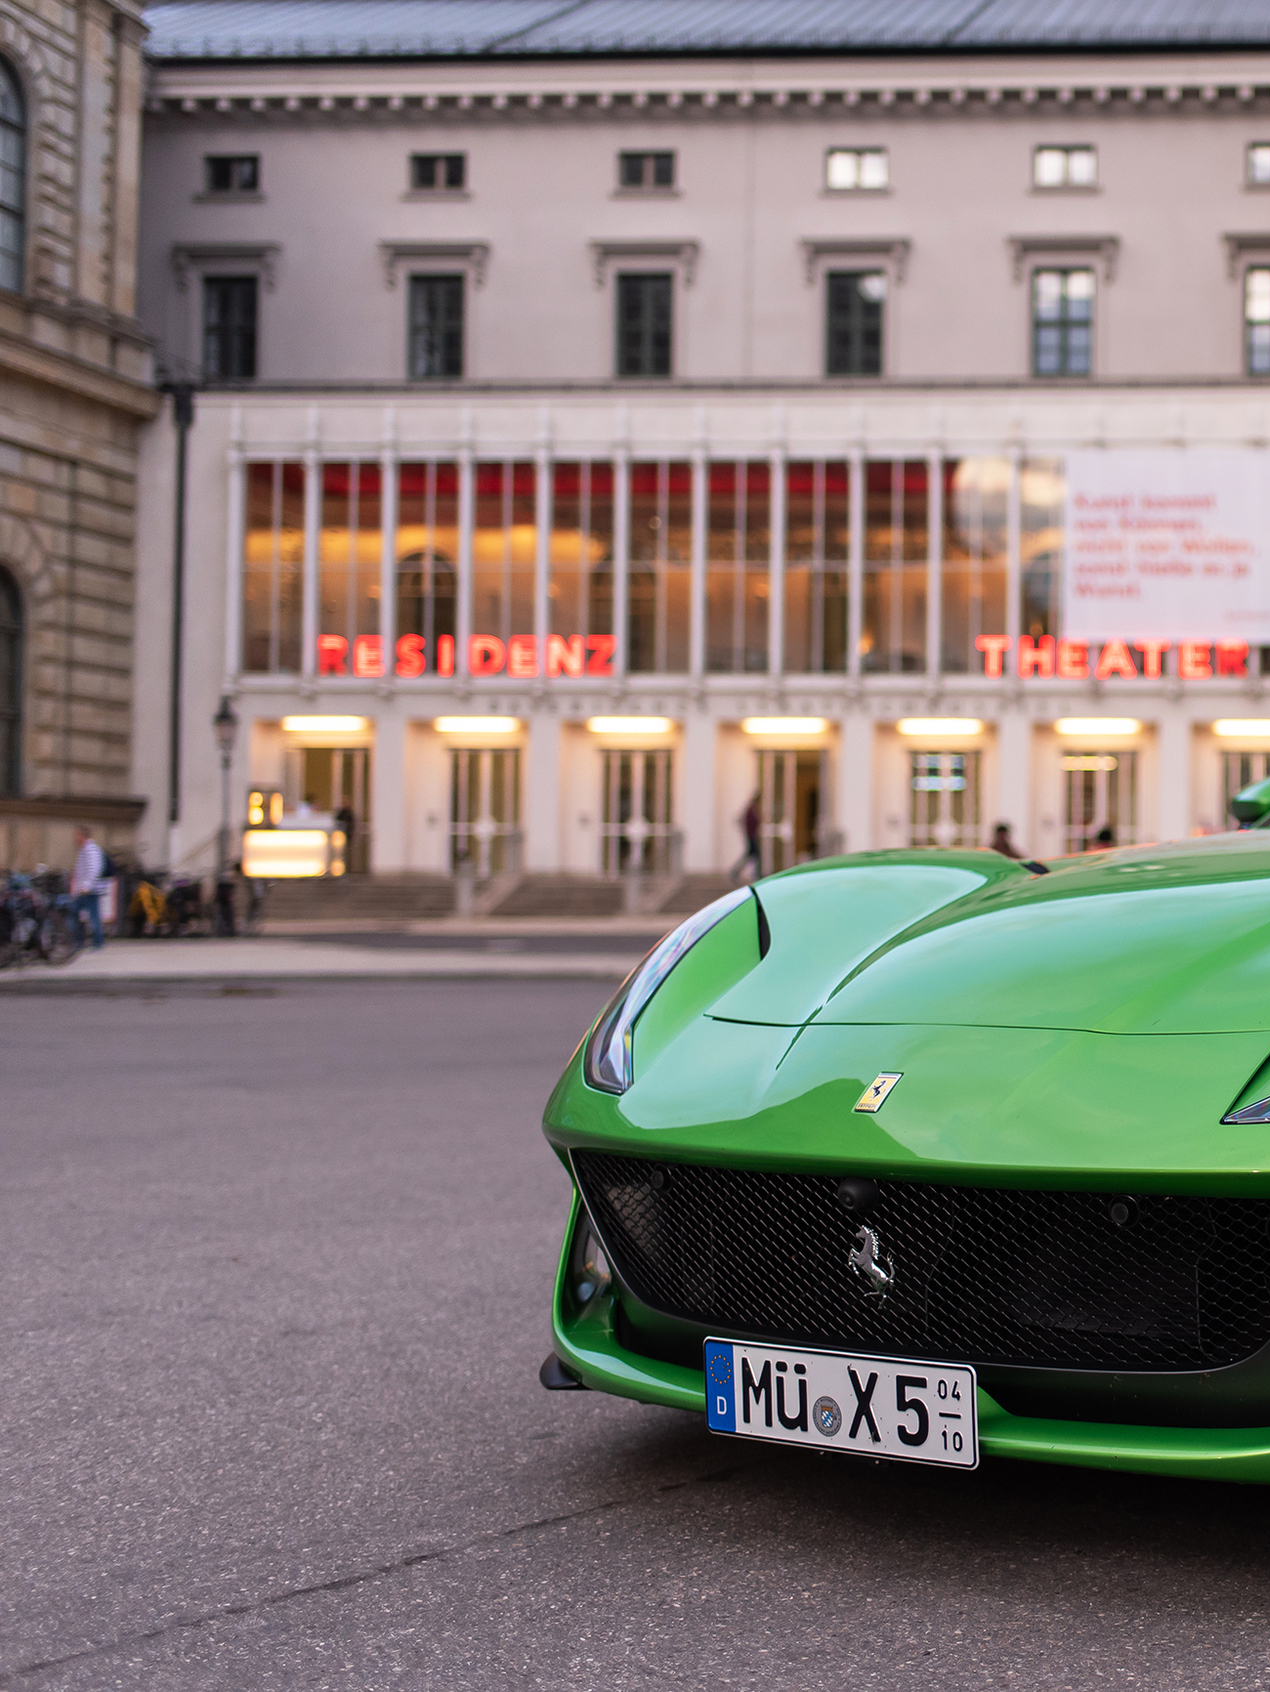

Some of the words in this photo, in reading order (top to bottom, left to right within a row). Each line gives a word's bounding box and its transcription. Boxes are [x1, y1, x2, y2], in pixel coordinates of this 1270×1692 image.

[317, 633, 617, 679] RESIDENZ
[974, 634, 1250, 680] THEATER
[937, 1379, 961, 1401] 04
[716, 1396, 727, 1415] D
[847, 1363, 882, 1443] X
[895, 1374, 930, 1447] 5
[942, 1428, 963, 1452] 10
